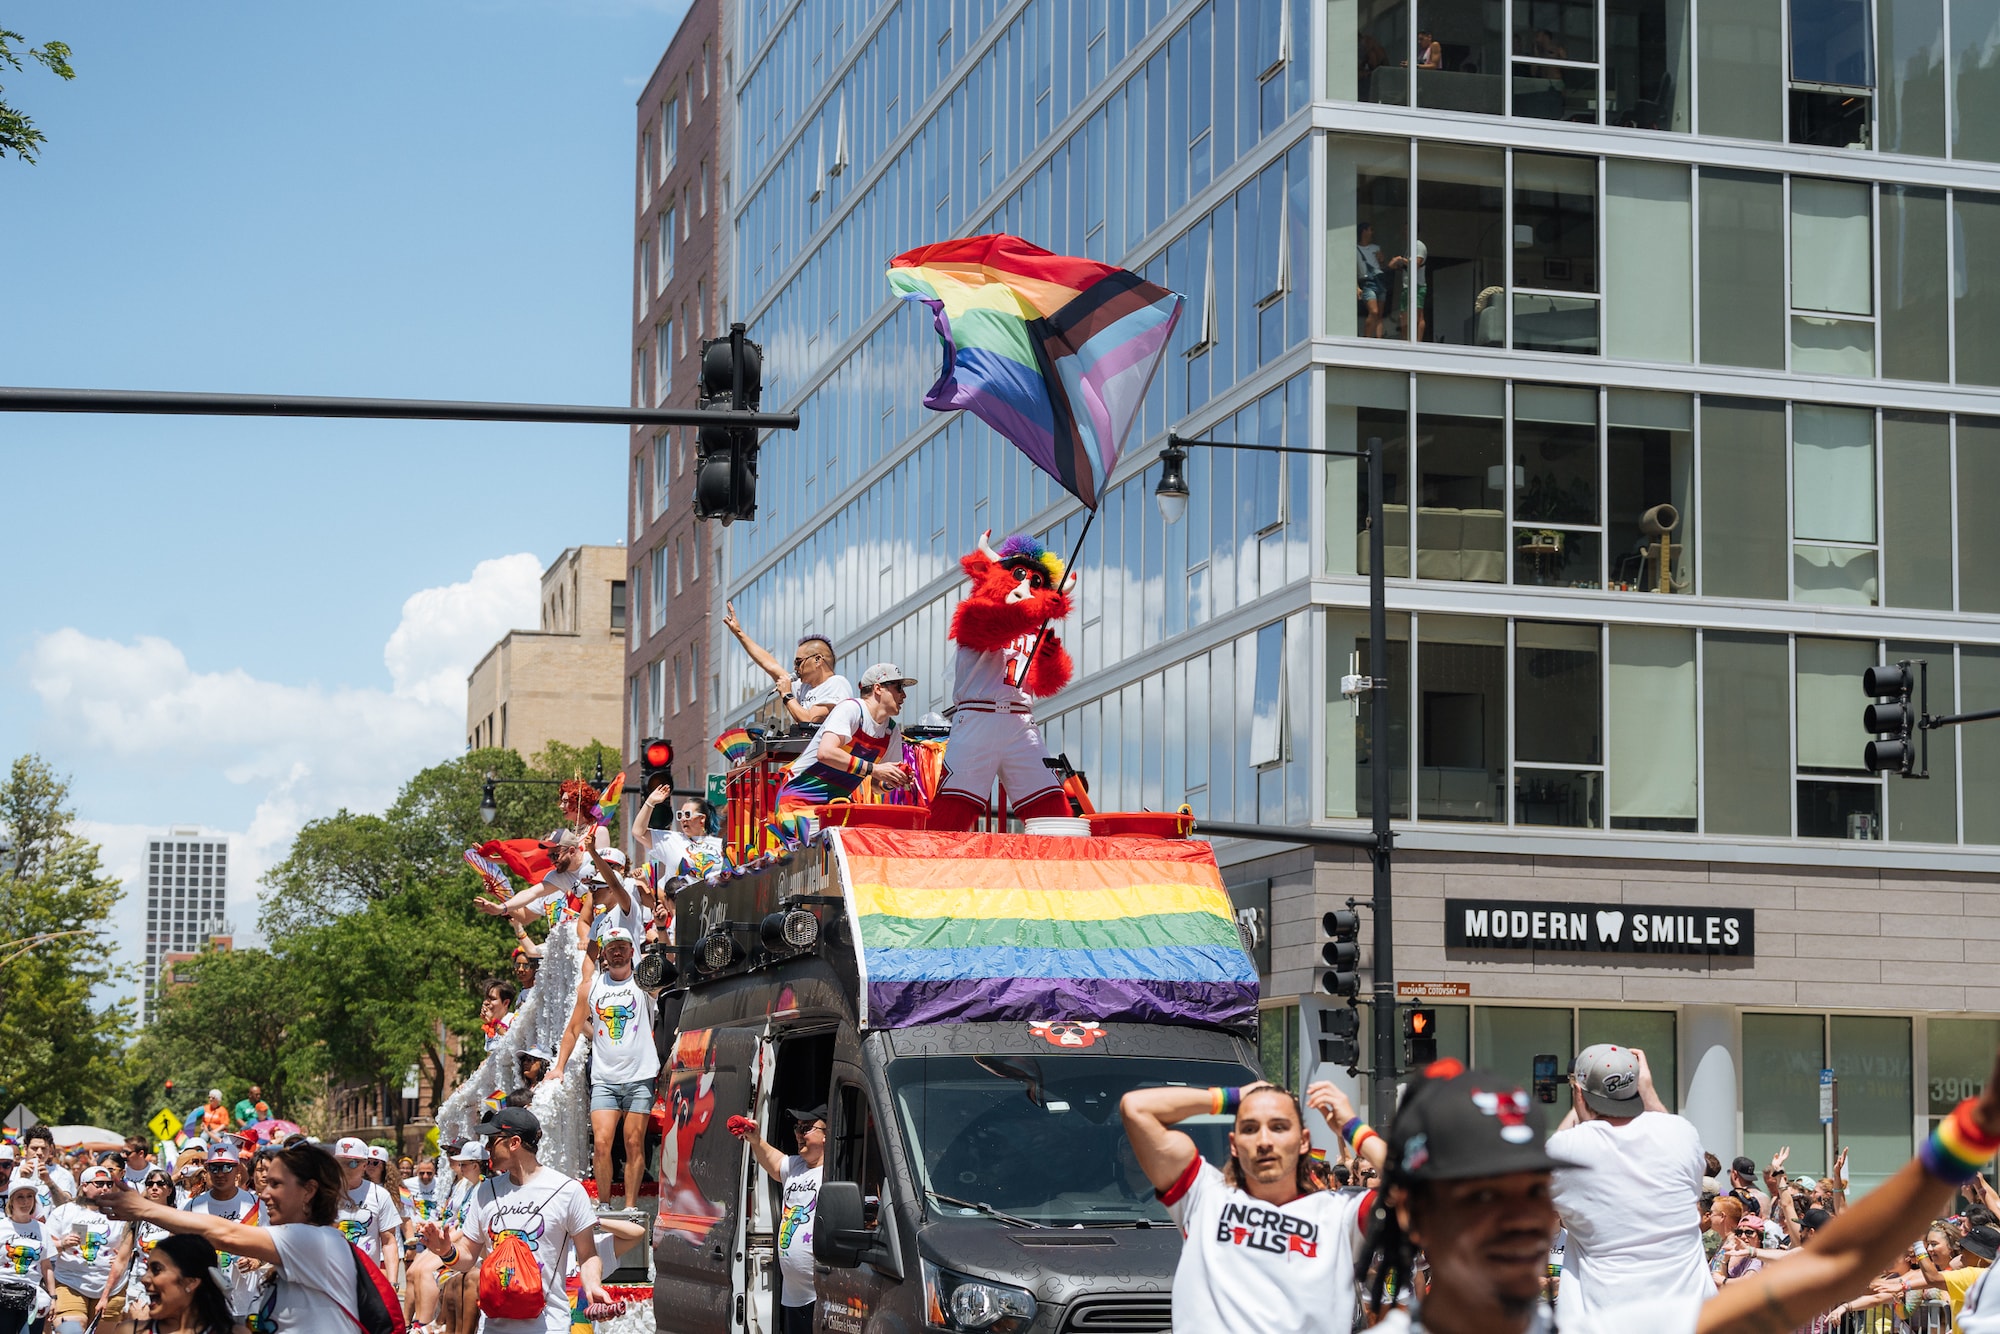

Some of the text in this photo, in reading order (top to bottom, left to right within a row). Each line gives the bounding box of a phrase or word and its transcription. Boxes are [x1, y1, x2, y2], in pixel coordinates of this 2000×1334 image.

[709, 781, 717, 791] W
[1464, 909, 1740, 945] MODERN SMILES
[600, 989, 632, 1004] pride
[1400, 986, 1427, 994] RICHARD
[1427, 986, 1457, 995] COTOVSKY
[786, 1179, 817, 1200] pride
[494, 1201, 540, 1226] pride
